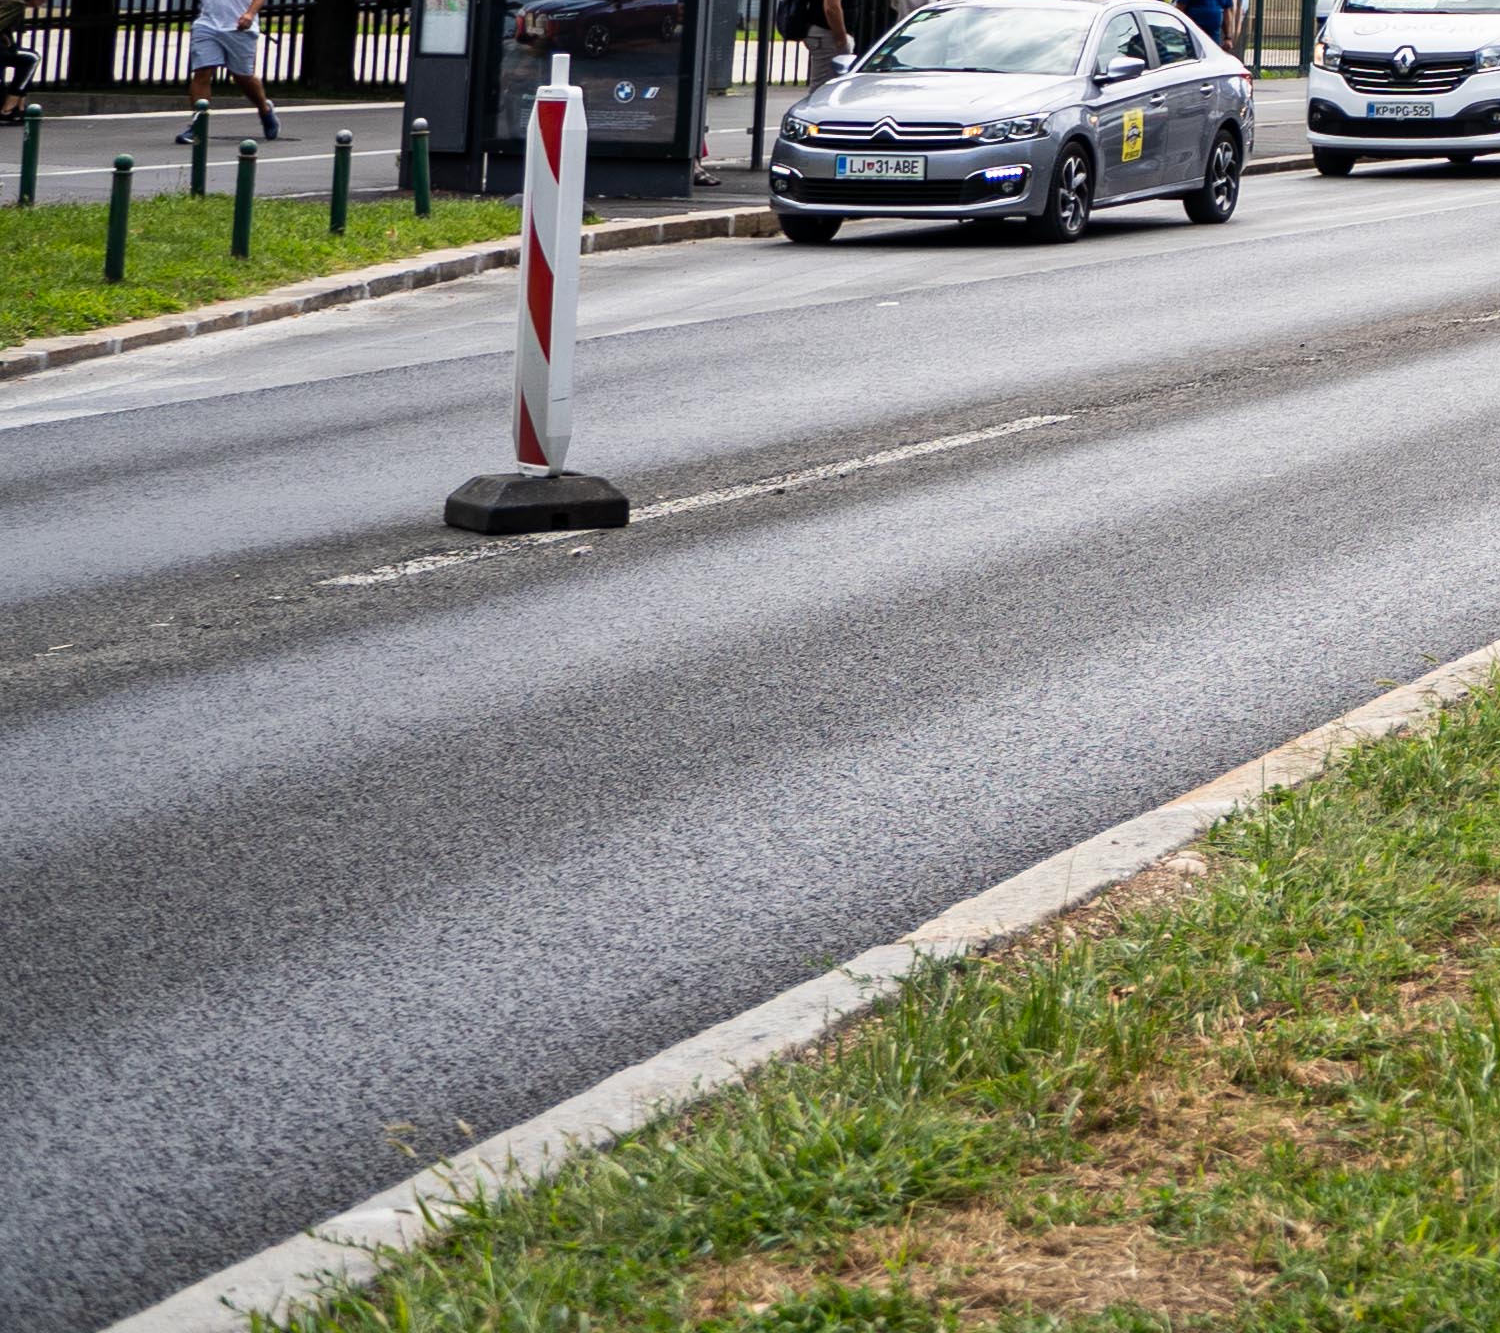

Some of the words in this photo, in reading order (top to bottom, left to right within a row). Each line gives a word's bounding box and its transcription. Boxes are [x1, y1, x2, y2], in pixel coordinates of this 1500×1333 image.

[1376, 106, 1388, 116] KP
[1396, 106, 1430, 116] PG-525
[850, 160, 865, 173] LJ
[875, 160, 919, 174] 31-ABE
